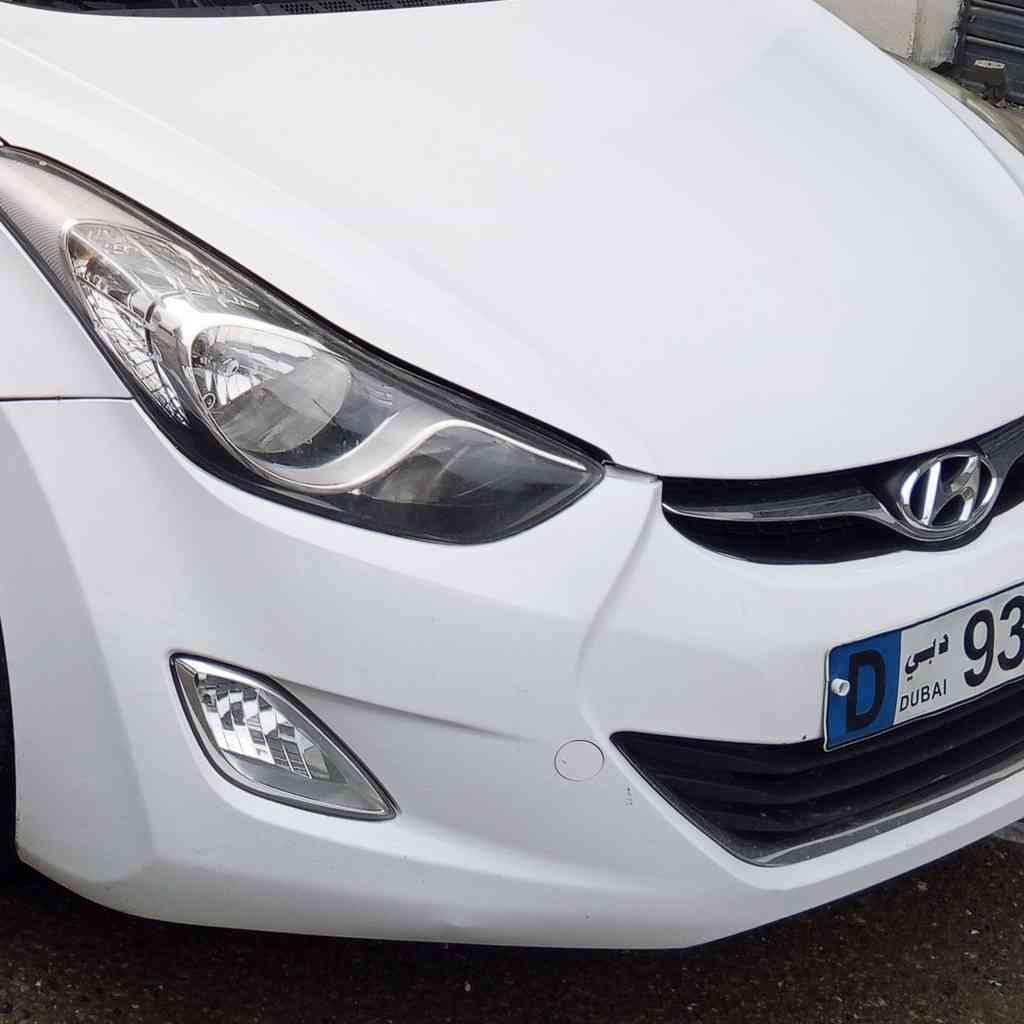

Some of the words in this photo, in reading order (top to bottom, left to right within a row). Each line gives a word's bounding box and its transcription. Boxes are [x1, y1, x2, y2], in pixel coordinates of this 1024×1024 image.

[963, 595, 1024, 687] 93
[847, 650, 886, 732] D
[899, 679, 947, 712] DUBAI
